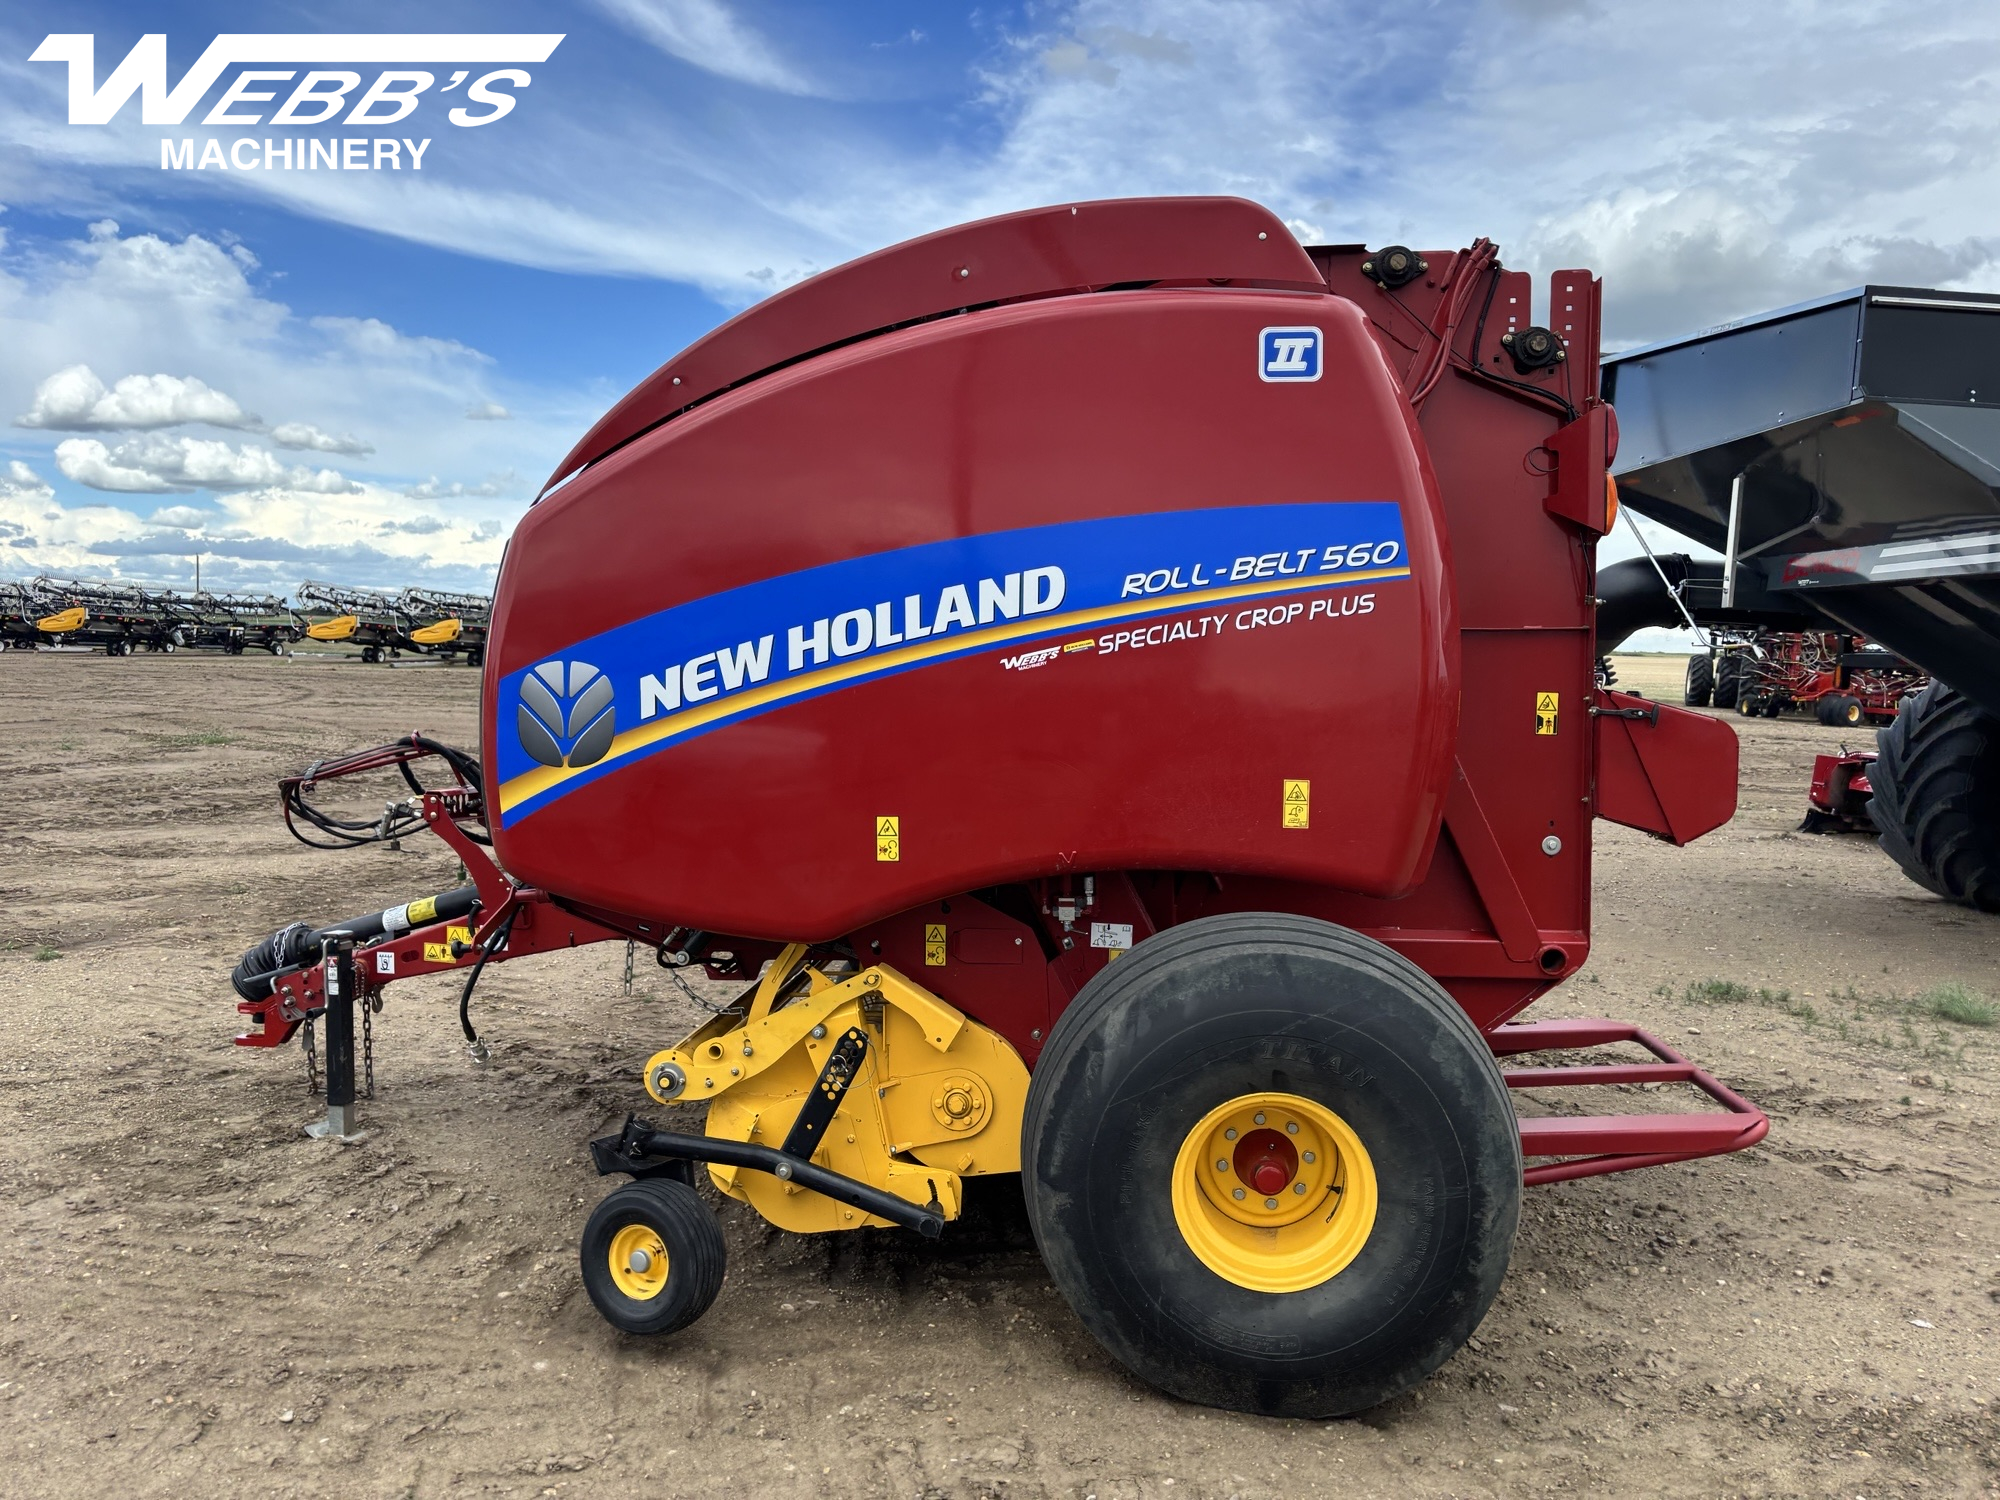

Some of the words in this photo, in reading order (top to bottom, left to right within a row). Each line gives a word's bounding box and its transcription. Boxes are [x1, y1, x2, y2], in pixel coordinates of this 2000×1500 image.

[1320, 540, 1400, 571] 560
[640, 634, 774, 720] NEW
[787, 565, 1067, 671] HOLLAND
[1098, 613, 1229, 655] SPECIALTY
[1235, 603, 1305, 631] CROP
[1309, 593, 1376, 621] PLUS
[1000, 645, 1062, 670] WEBB'S
[1018, 660, 1048, 671] MACHINERY
[1260, 1039, 1377, 1087] TITAN
